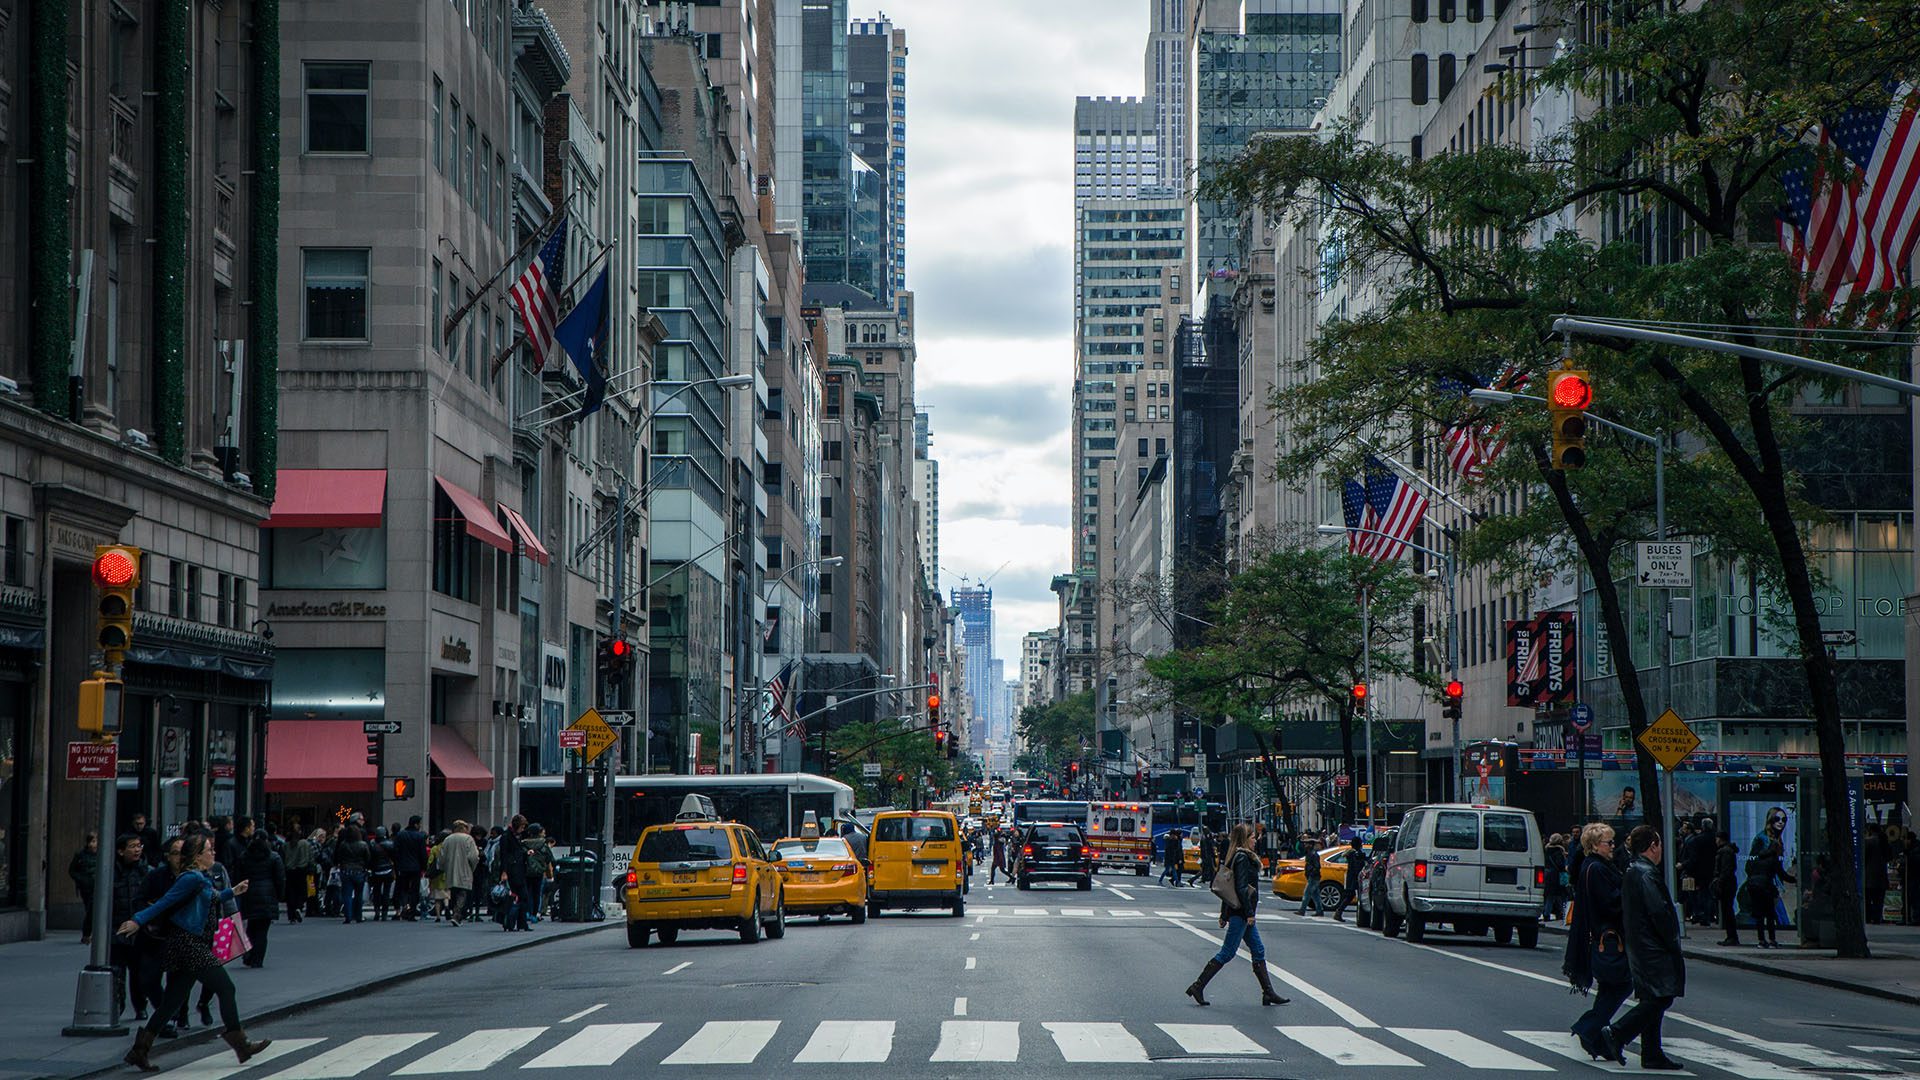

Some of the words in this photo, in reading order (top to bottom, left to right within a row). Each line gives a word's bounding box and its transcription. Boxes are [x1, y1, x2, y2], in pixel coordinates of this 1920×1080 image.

[1647, 545, 1682, 554] BUSES
[1650, 561, 1678, 570] ONLY
[267, 601, 328, 617] American
[329, 601, 352, 617] Girl
[352, 602, 386, 617] Place
[1722, 595, 1844, 616] TOPSOP
[1548, 622, 1562, 630] TGI
[1516, 630, 1530, 638] TGI
[1836, 633, 1851, 641] WAY
[1548, 629, 1562, 692] FRIDAYS
[574, 724, 608, 732] RECESSED
[1651, 728, 1689, 736] RECESSED
[1648, 735, 1692, 745] CROSSWALK
[71, 745, 81, 754] NO
[83, 745, 115, 754] STOPPING
[1665, 745, 1671, 753] 5
[76, 756, 110, 765] ANYTIME
